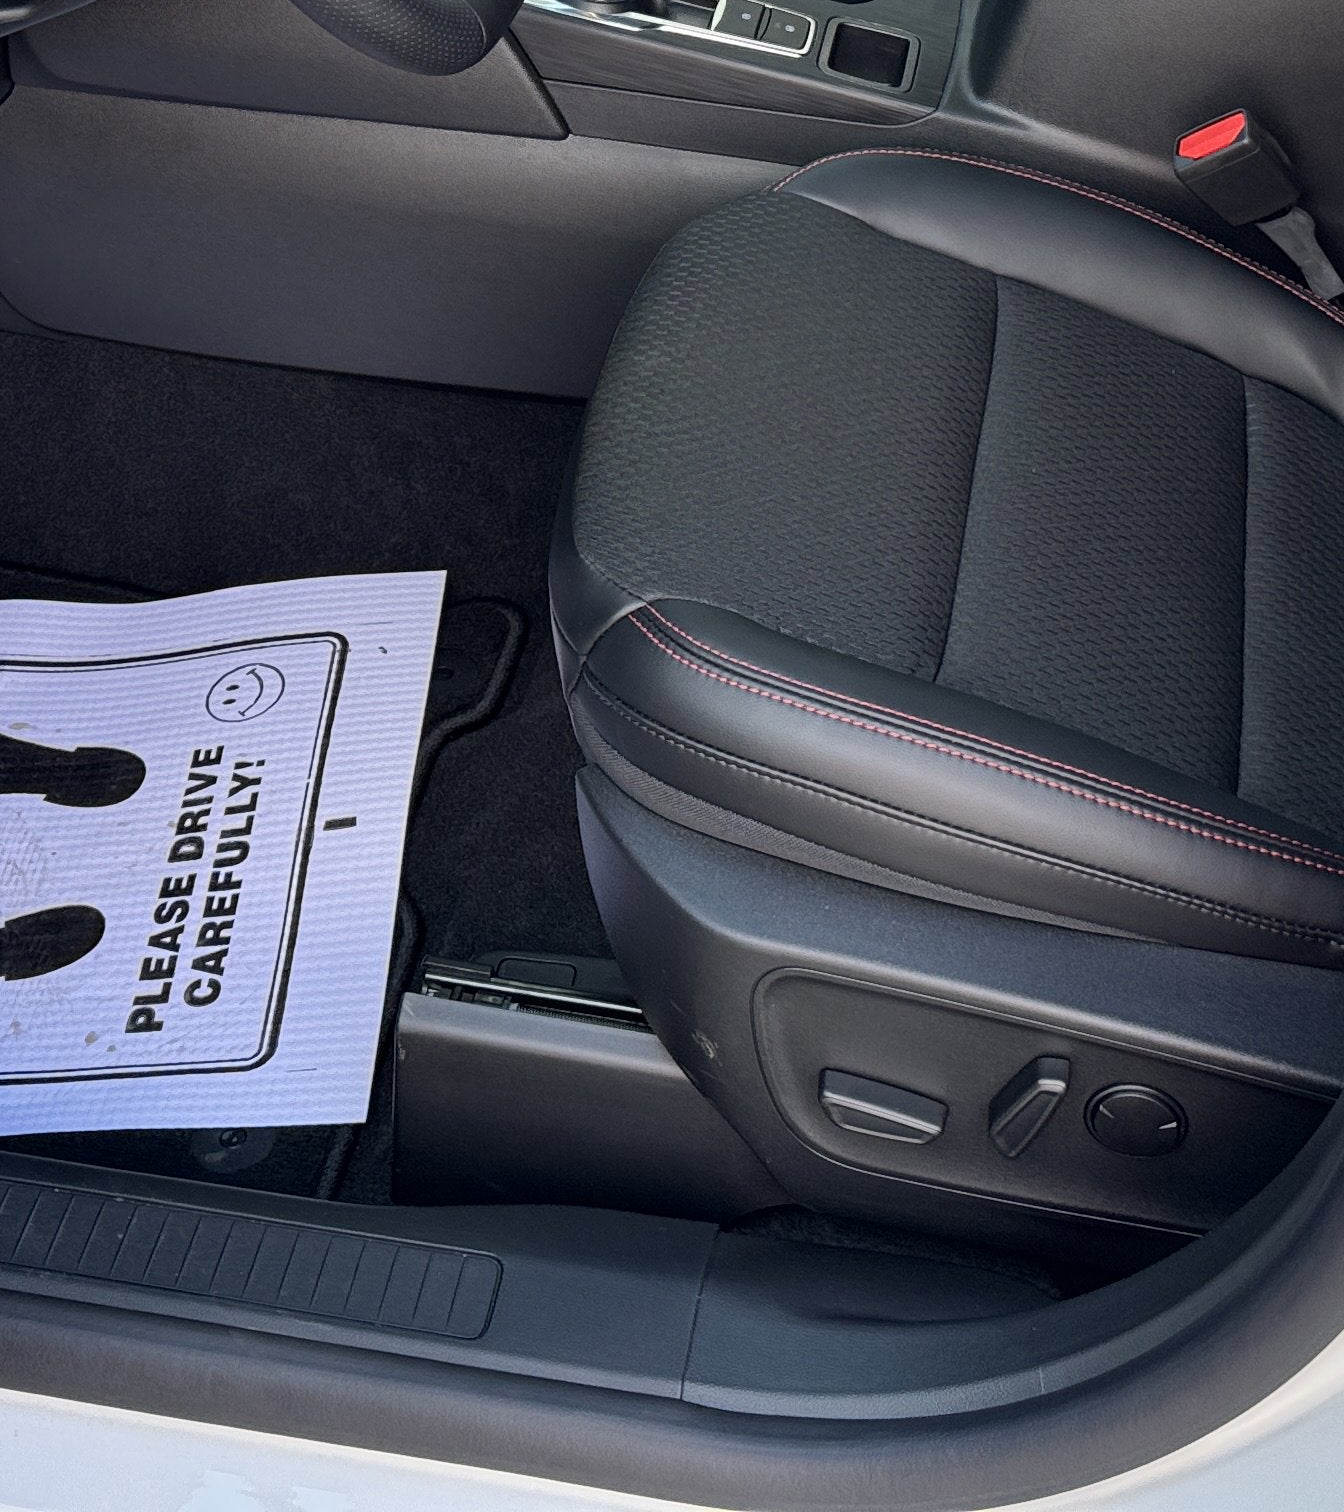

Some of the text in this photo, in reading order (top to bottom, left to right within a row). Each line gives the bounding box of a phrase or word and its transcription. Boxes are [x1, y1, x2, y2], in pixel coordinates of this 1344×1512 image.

[124, 744, 224, 1034] PLEASE DRIVE
[183, 759, 266, 1007] CAREFULLY!
